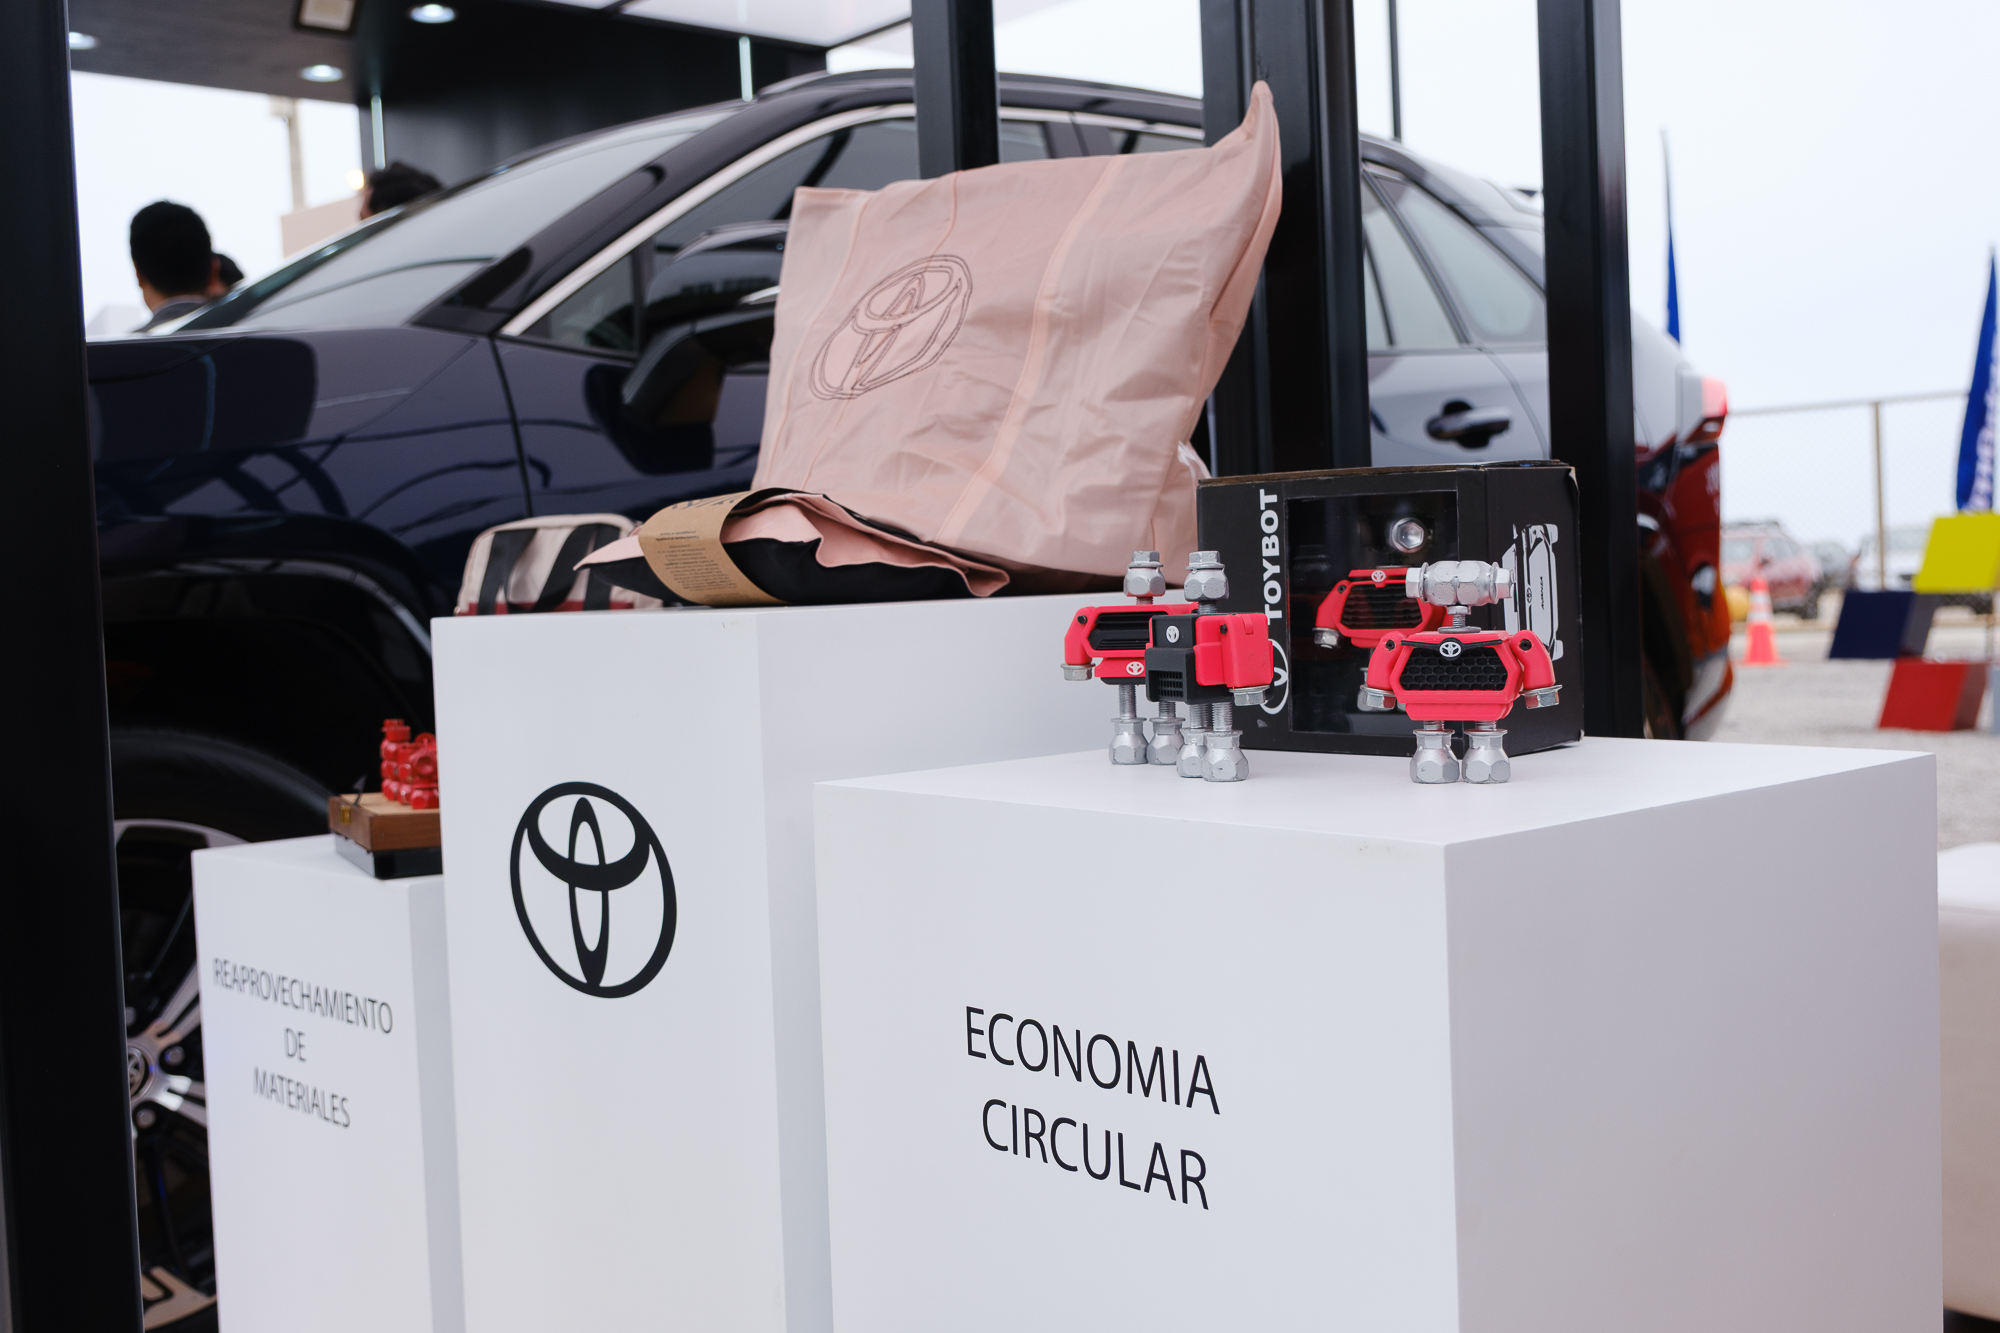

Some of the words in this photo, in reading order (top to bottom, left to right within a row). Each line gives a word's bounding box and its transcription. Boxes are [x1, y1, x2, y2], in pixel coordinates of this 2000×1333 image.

[1259, 488, 1283, 626] TOYBOT
[213, 957, 394, 1035] REAPROVECHAMIENTO
[285, 1027, 307, 1063] DE
[966, 1005, 1221, 1115] ECONOMIA
[253, 1066, 351, 1129] MATERIALES
[982, 1098, 1209, 1210] CIRCULAR
